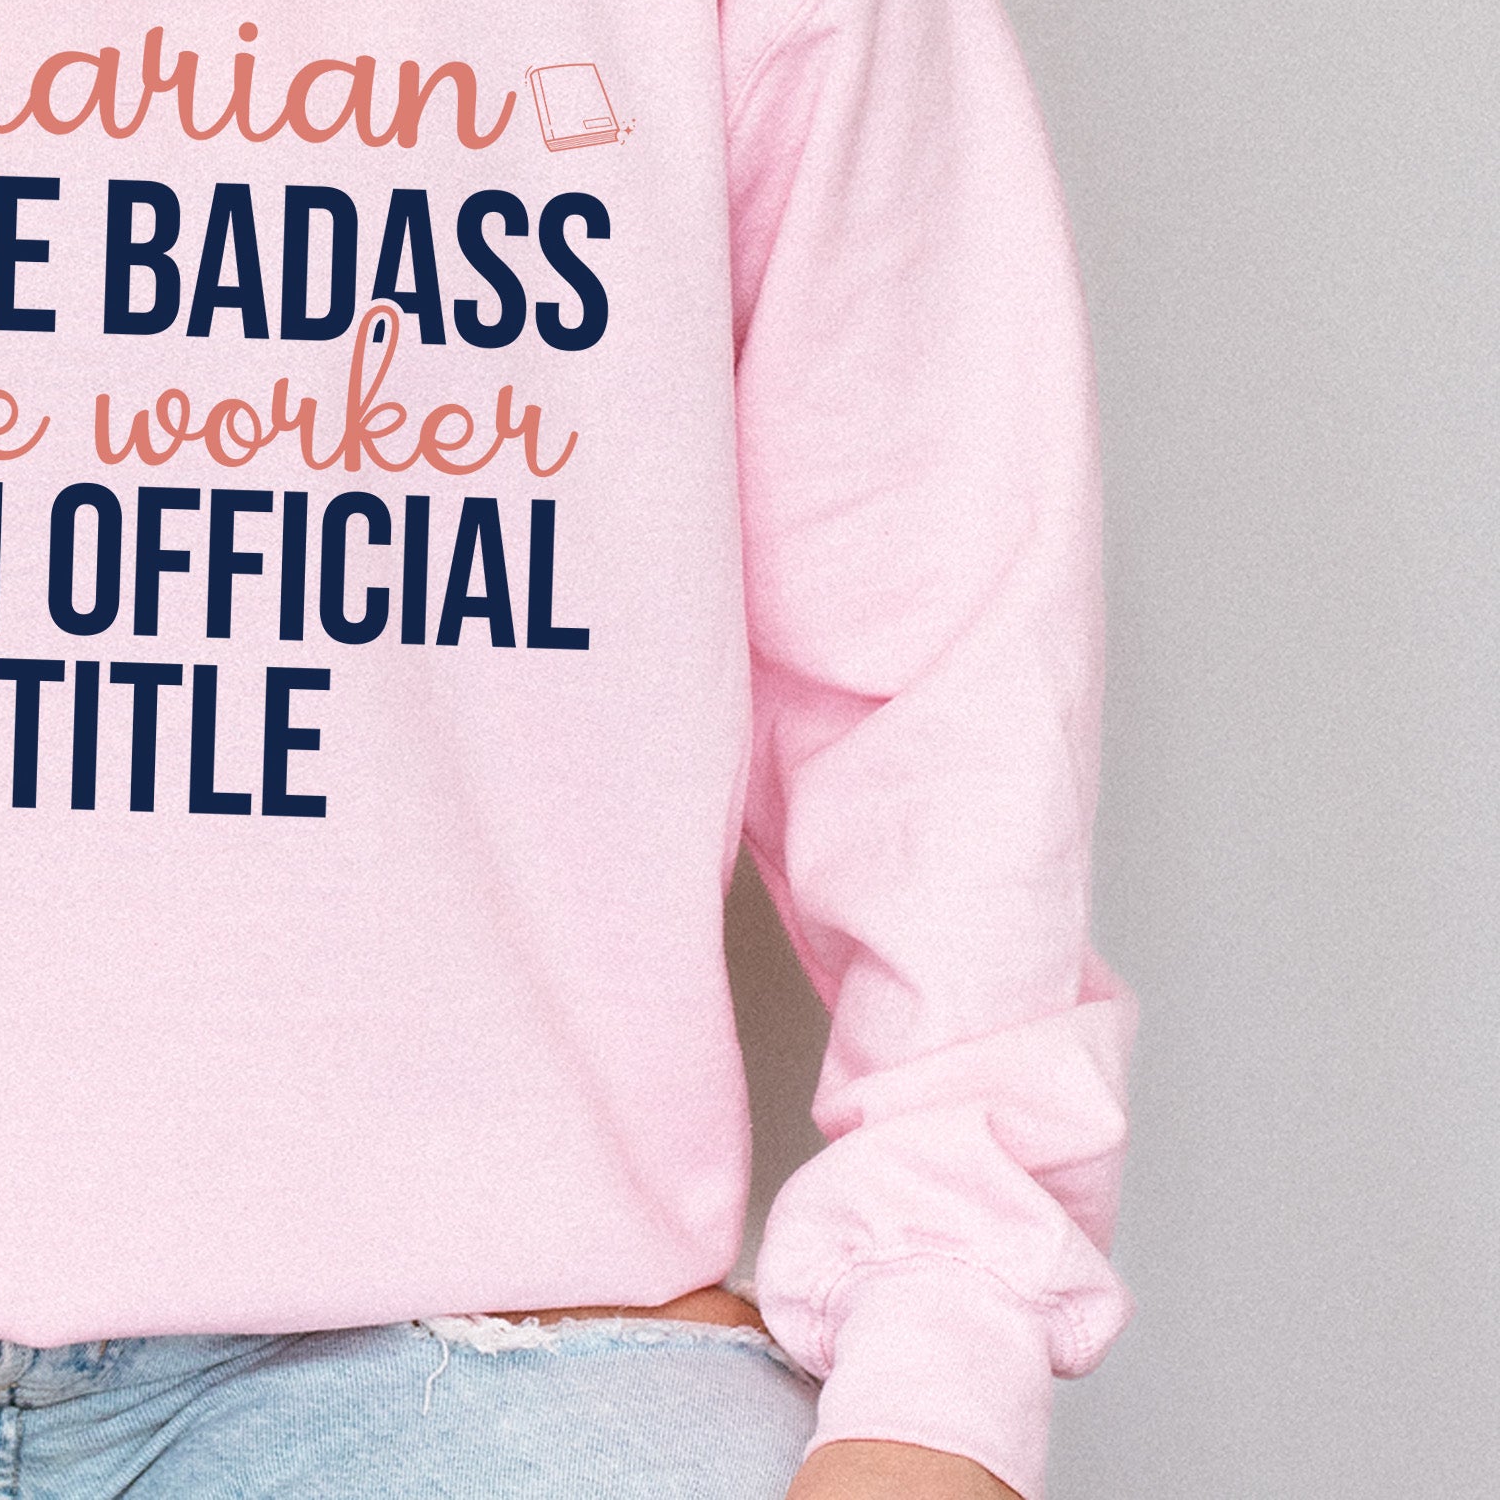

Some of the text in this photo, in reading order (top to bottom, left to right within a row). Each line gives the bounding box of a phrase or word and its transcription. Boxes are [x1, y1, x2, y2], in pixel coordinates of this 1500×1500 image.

[103, 179, 611, 352] BADASS
[94, 304, 579, 478] worker
[48, 482, 590, 651] OFFICIAL
